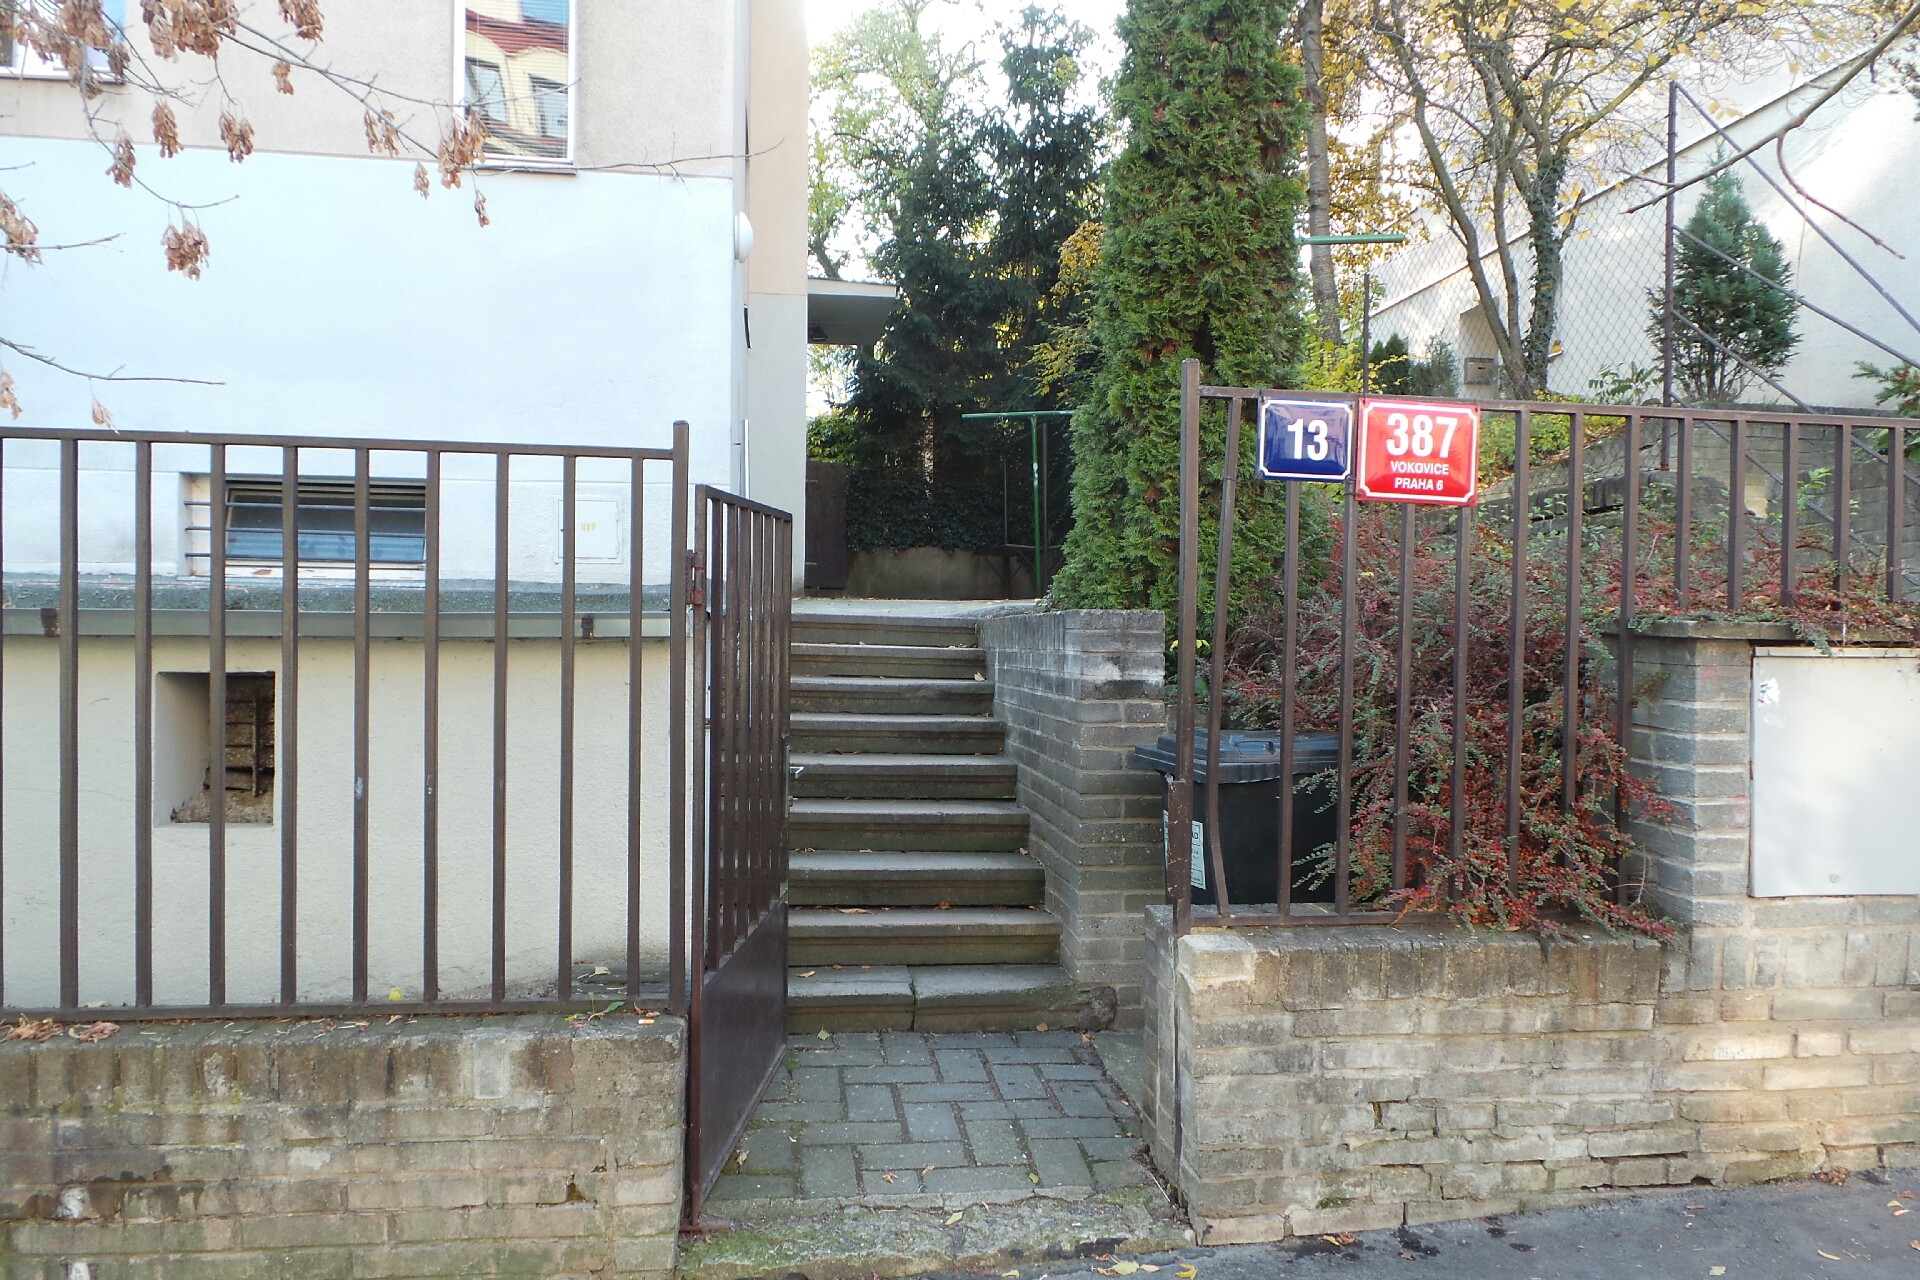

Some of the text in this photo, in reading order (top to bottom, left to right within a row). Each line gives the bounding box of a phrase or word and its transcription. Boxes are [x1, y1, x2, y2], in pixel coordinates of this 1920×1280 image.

[1287, 418, 1329, 461] 13
[1386, 412, 1458, 459] 387
[1390, 460, 1450, 476] VOKOVICE
[1394, 477, 1444, 491] PRAHA 6
